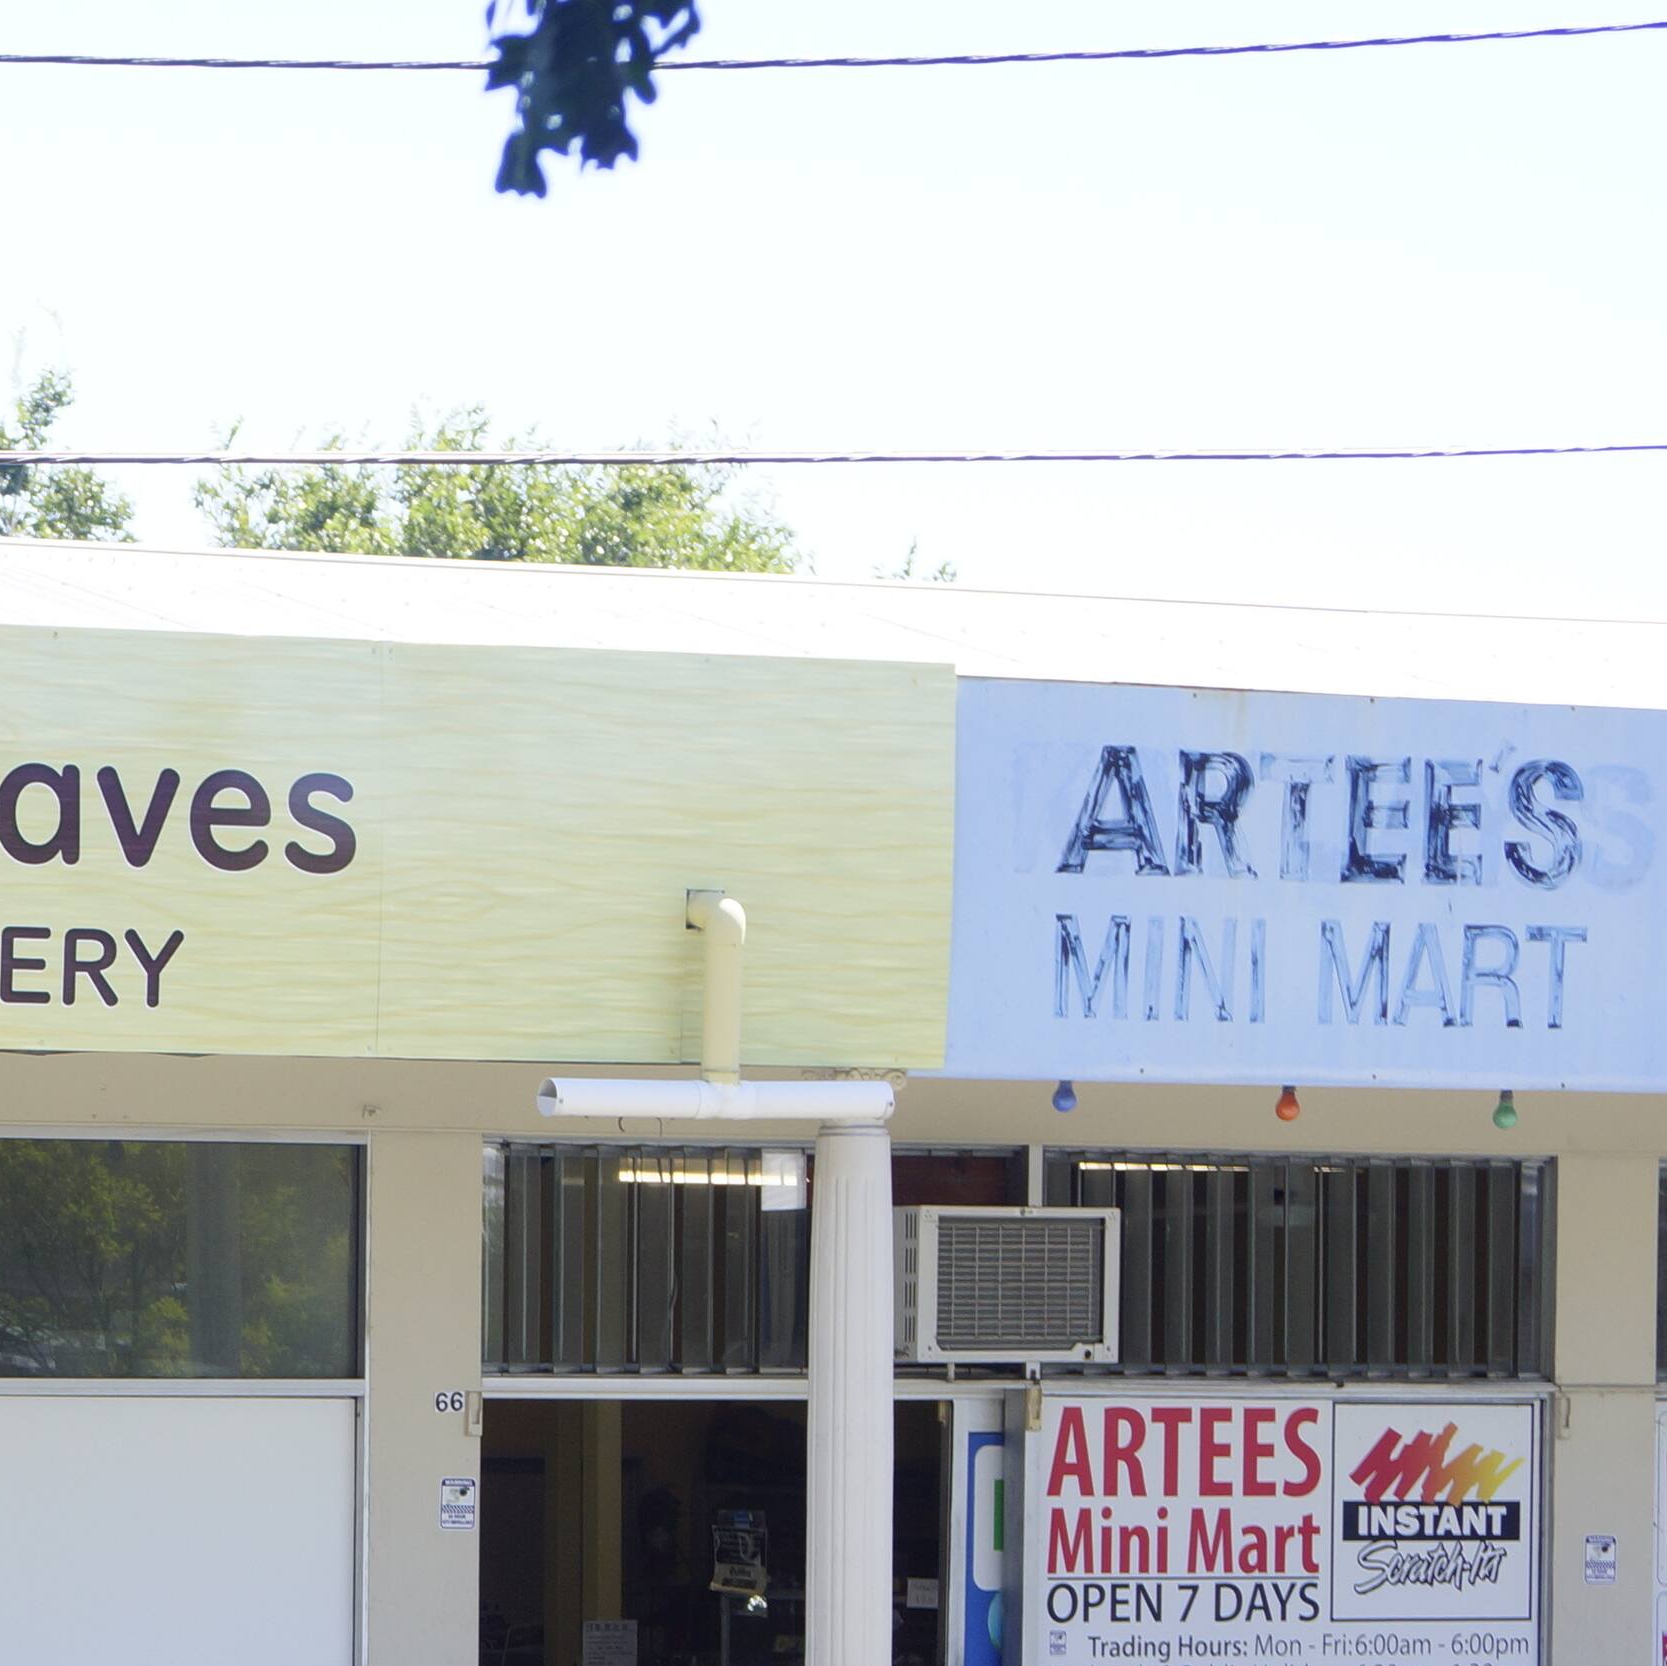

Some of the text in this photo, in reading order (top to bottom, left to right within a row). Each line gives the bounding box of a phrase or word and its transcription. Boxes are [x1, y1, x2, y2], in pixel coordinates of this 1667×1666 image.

[1054, 913, 1588, 1029] MINI MART
[435, 1391, 464, 1412] 66
[1046, 1406, 1322, 1497] ARTEES
[1046, 1506, 1168, 1575] Mini
[1187, 1507, 1322, 1575] Mart
[1357, 1504, 1507, 1537] INSTANT
[1046, 1581, 1321, 1624] OPEN 7 DAYS
[1088, 1634, 1171, 1663] Trading
[1178, 1634, 1248, 1658] Hours:
[1254, 1633, 1302, 1657] Mon
[1451, 1632, 1530, 1660] 6:00pm
